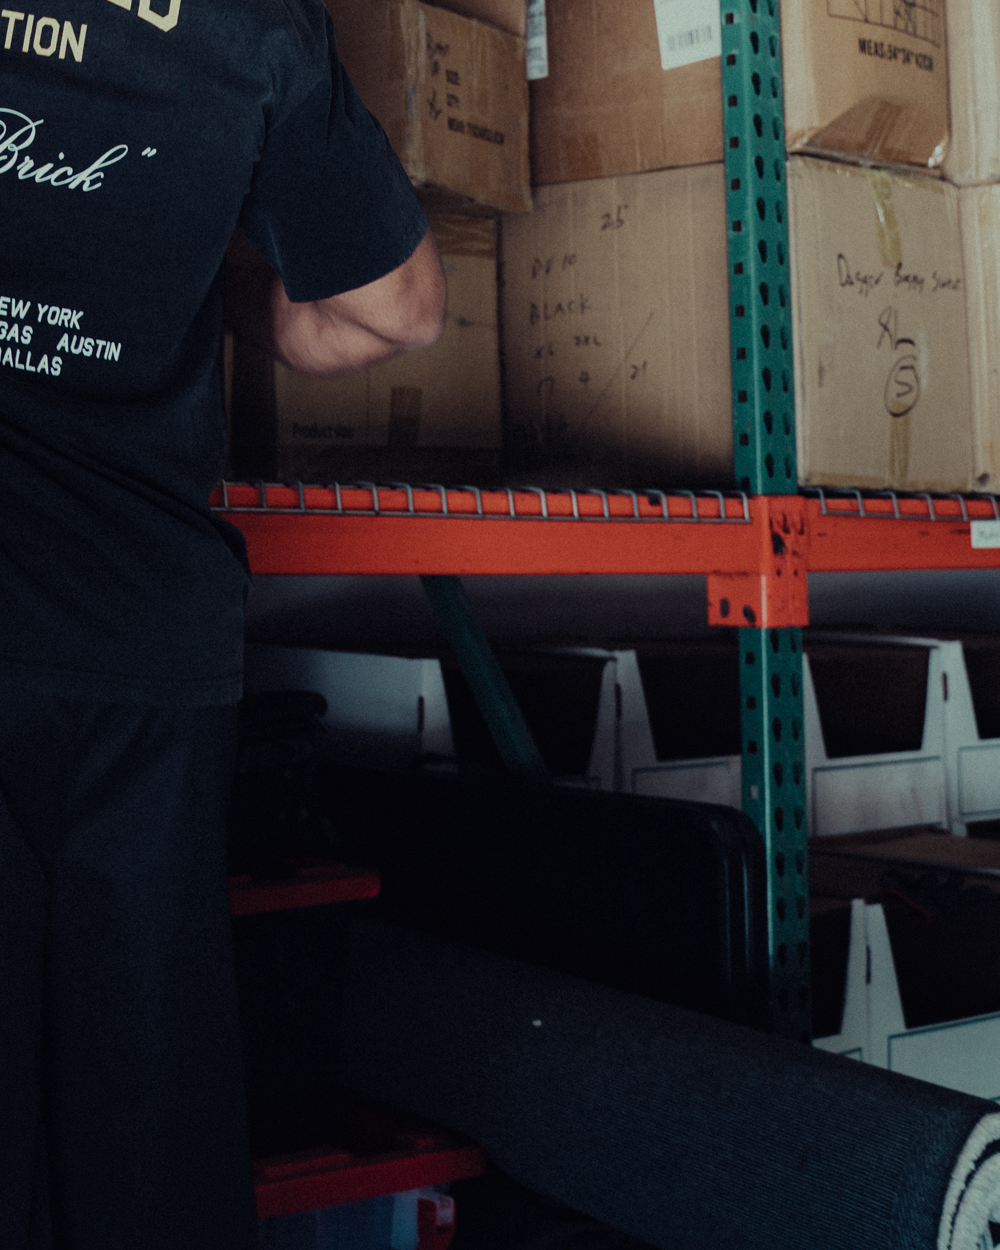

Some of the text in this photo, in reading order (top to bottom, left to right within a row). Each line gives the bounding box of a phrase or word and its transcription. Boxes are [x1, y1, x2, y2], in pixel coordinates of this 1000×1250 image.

[37, 302, 84, 330] YORK
[529, 293, 592, 325] BLACK
[56, 332, 121, 362] AUSTIN
